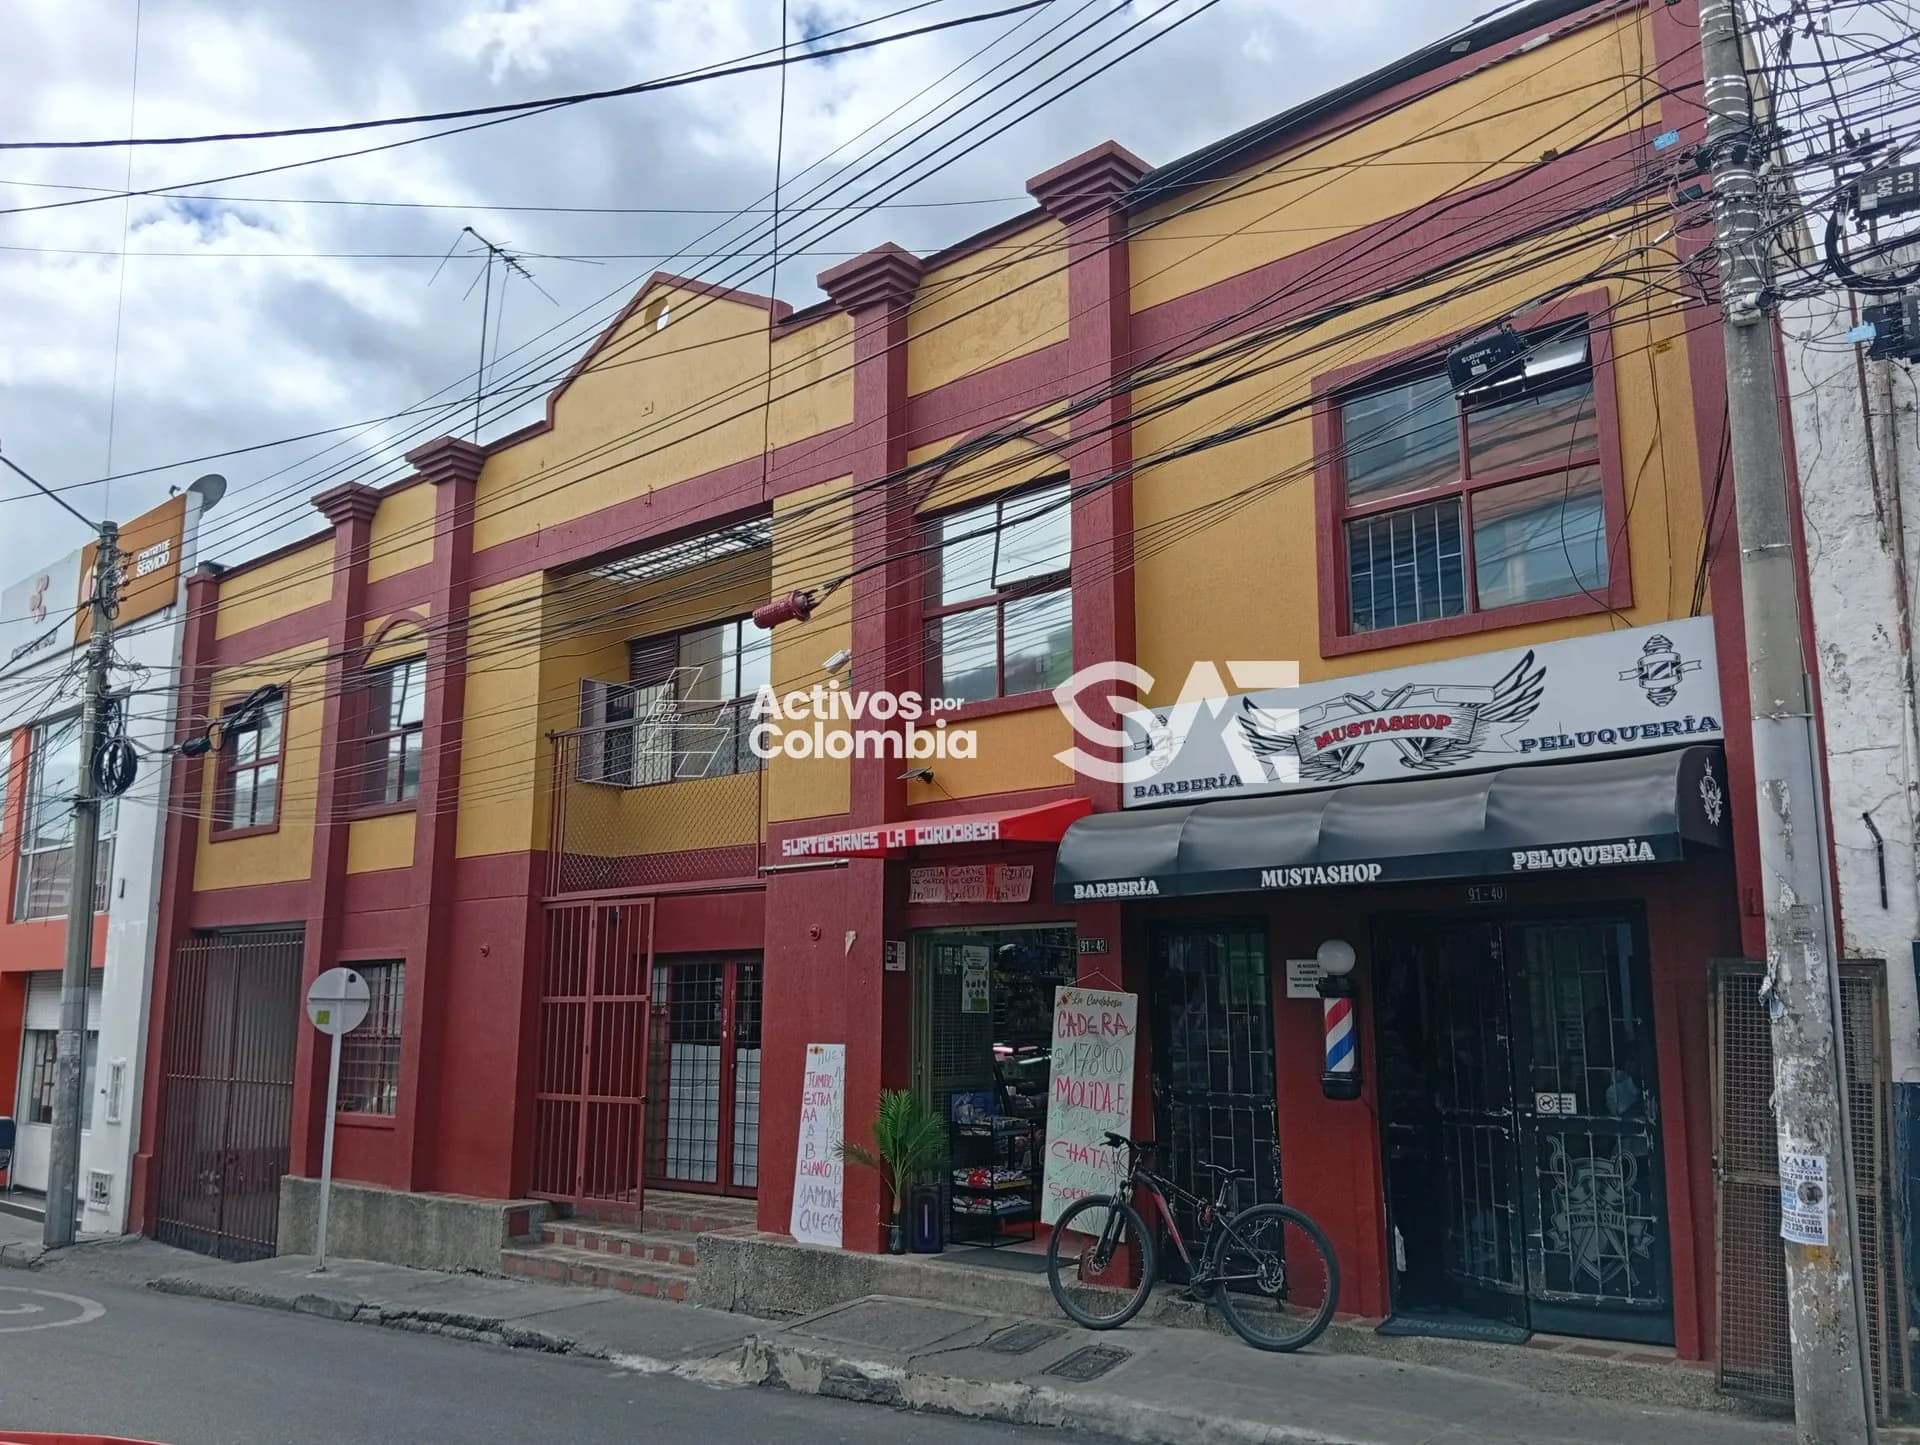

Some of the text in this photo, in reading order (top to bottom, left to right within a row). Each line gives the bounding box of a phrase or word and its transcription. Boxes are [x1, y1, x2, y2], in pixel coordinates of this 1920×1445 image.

[1314, 714, 1452, 750] MUSTASHOP
[1519, 715, 1721, 753] PELUQUERÍA
[1133, 774, 1243, 798] BARBERÍA
[886, 831, 906, 848] LA
[915, 822, 1000, 845] CORDOBESA
[1512, 838, 1655, 869] PELUQUERÍA
[950, 865, 985, 877] CARNE
[1261, 863, 1382, 888] MUSTASHOP
[1074, 877, 1159, 899] BARBERÍA
[1058, 1010, 1128, 1039] CADERA
[803, 1092, 832, 1106] EXTRA
[805, 1142, 816, 1160] B
